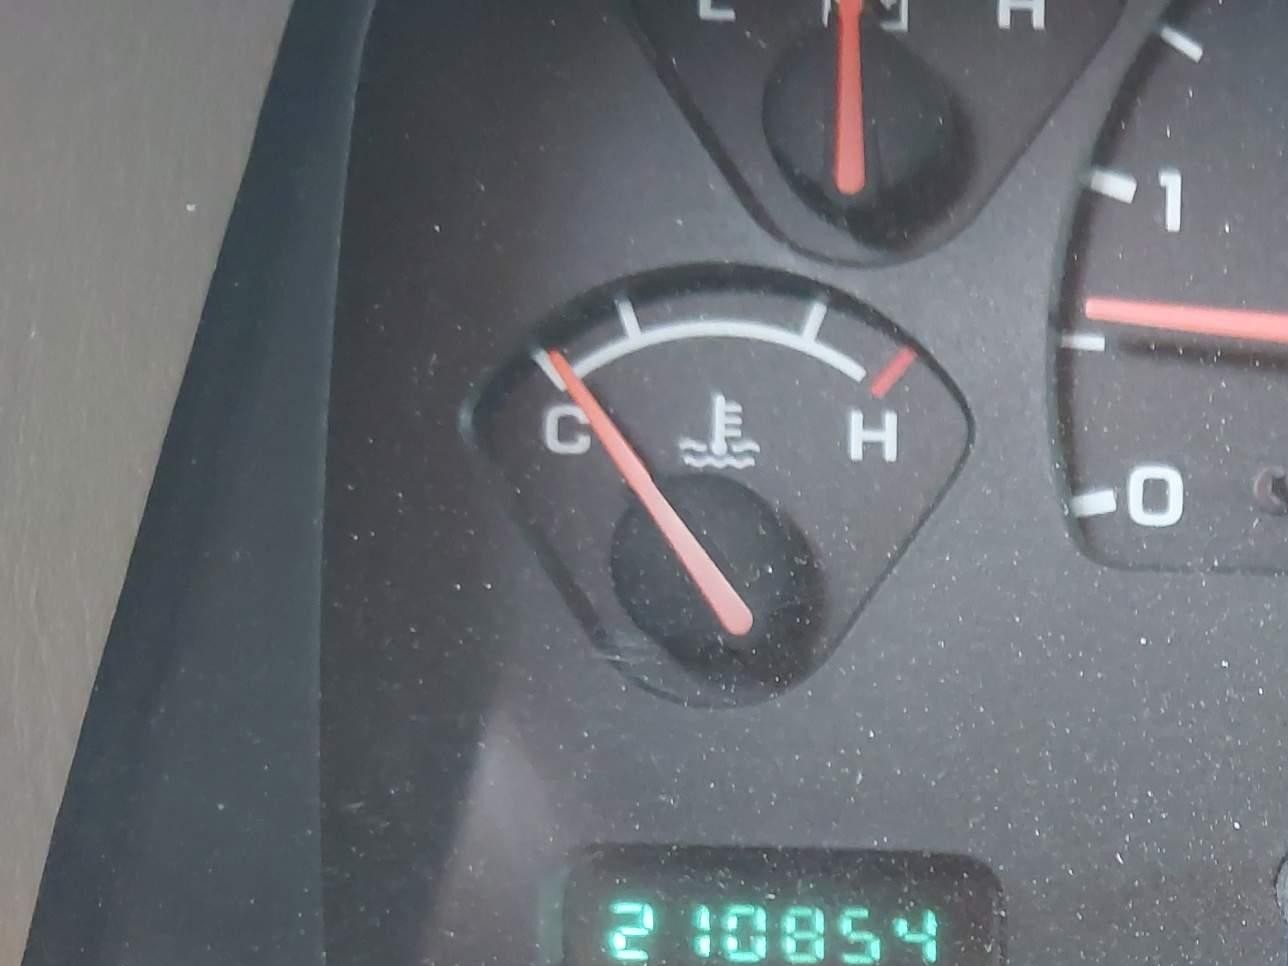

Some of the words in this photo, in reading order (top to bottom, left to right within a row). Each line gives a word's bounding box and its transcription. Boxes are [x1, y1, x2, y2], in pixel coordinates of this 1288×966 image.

[1159, 169, 1182, 232] 1
[545, 406, 592, 454] C
[847, 411, 898, 463] H
[1127, 465, 1184, 527] 0
[607, 902, 939, 965] 210854
